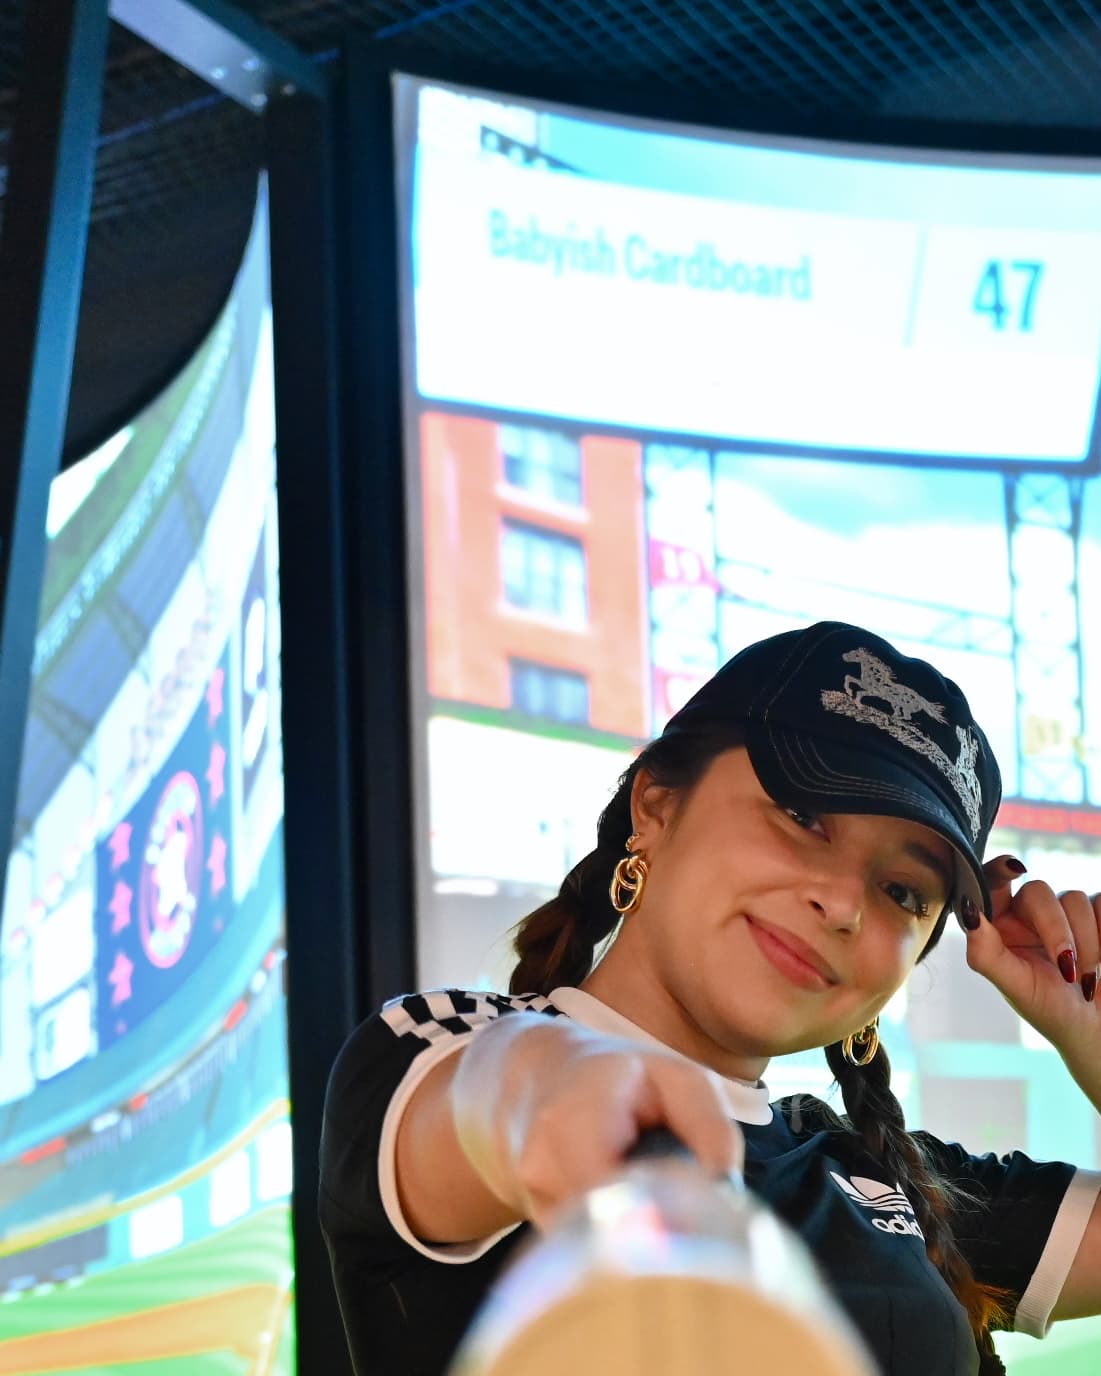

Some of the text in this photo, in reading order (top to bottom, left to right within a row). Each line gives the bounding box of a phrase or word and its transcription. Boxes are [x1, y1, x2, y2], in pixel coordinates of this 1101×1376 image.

[488, 209, 811, 301] Babyish Cardboard
[972, 260, 1045, 332] 47
